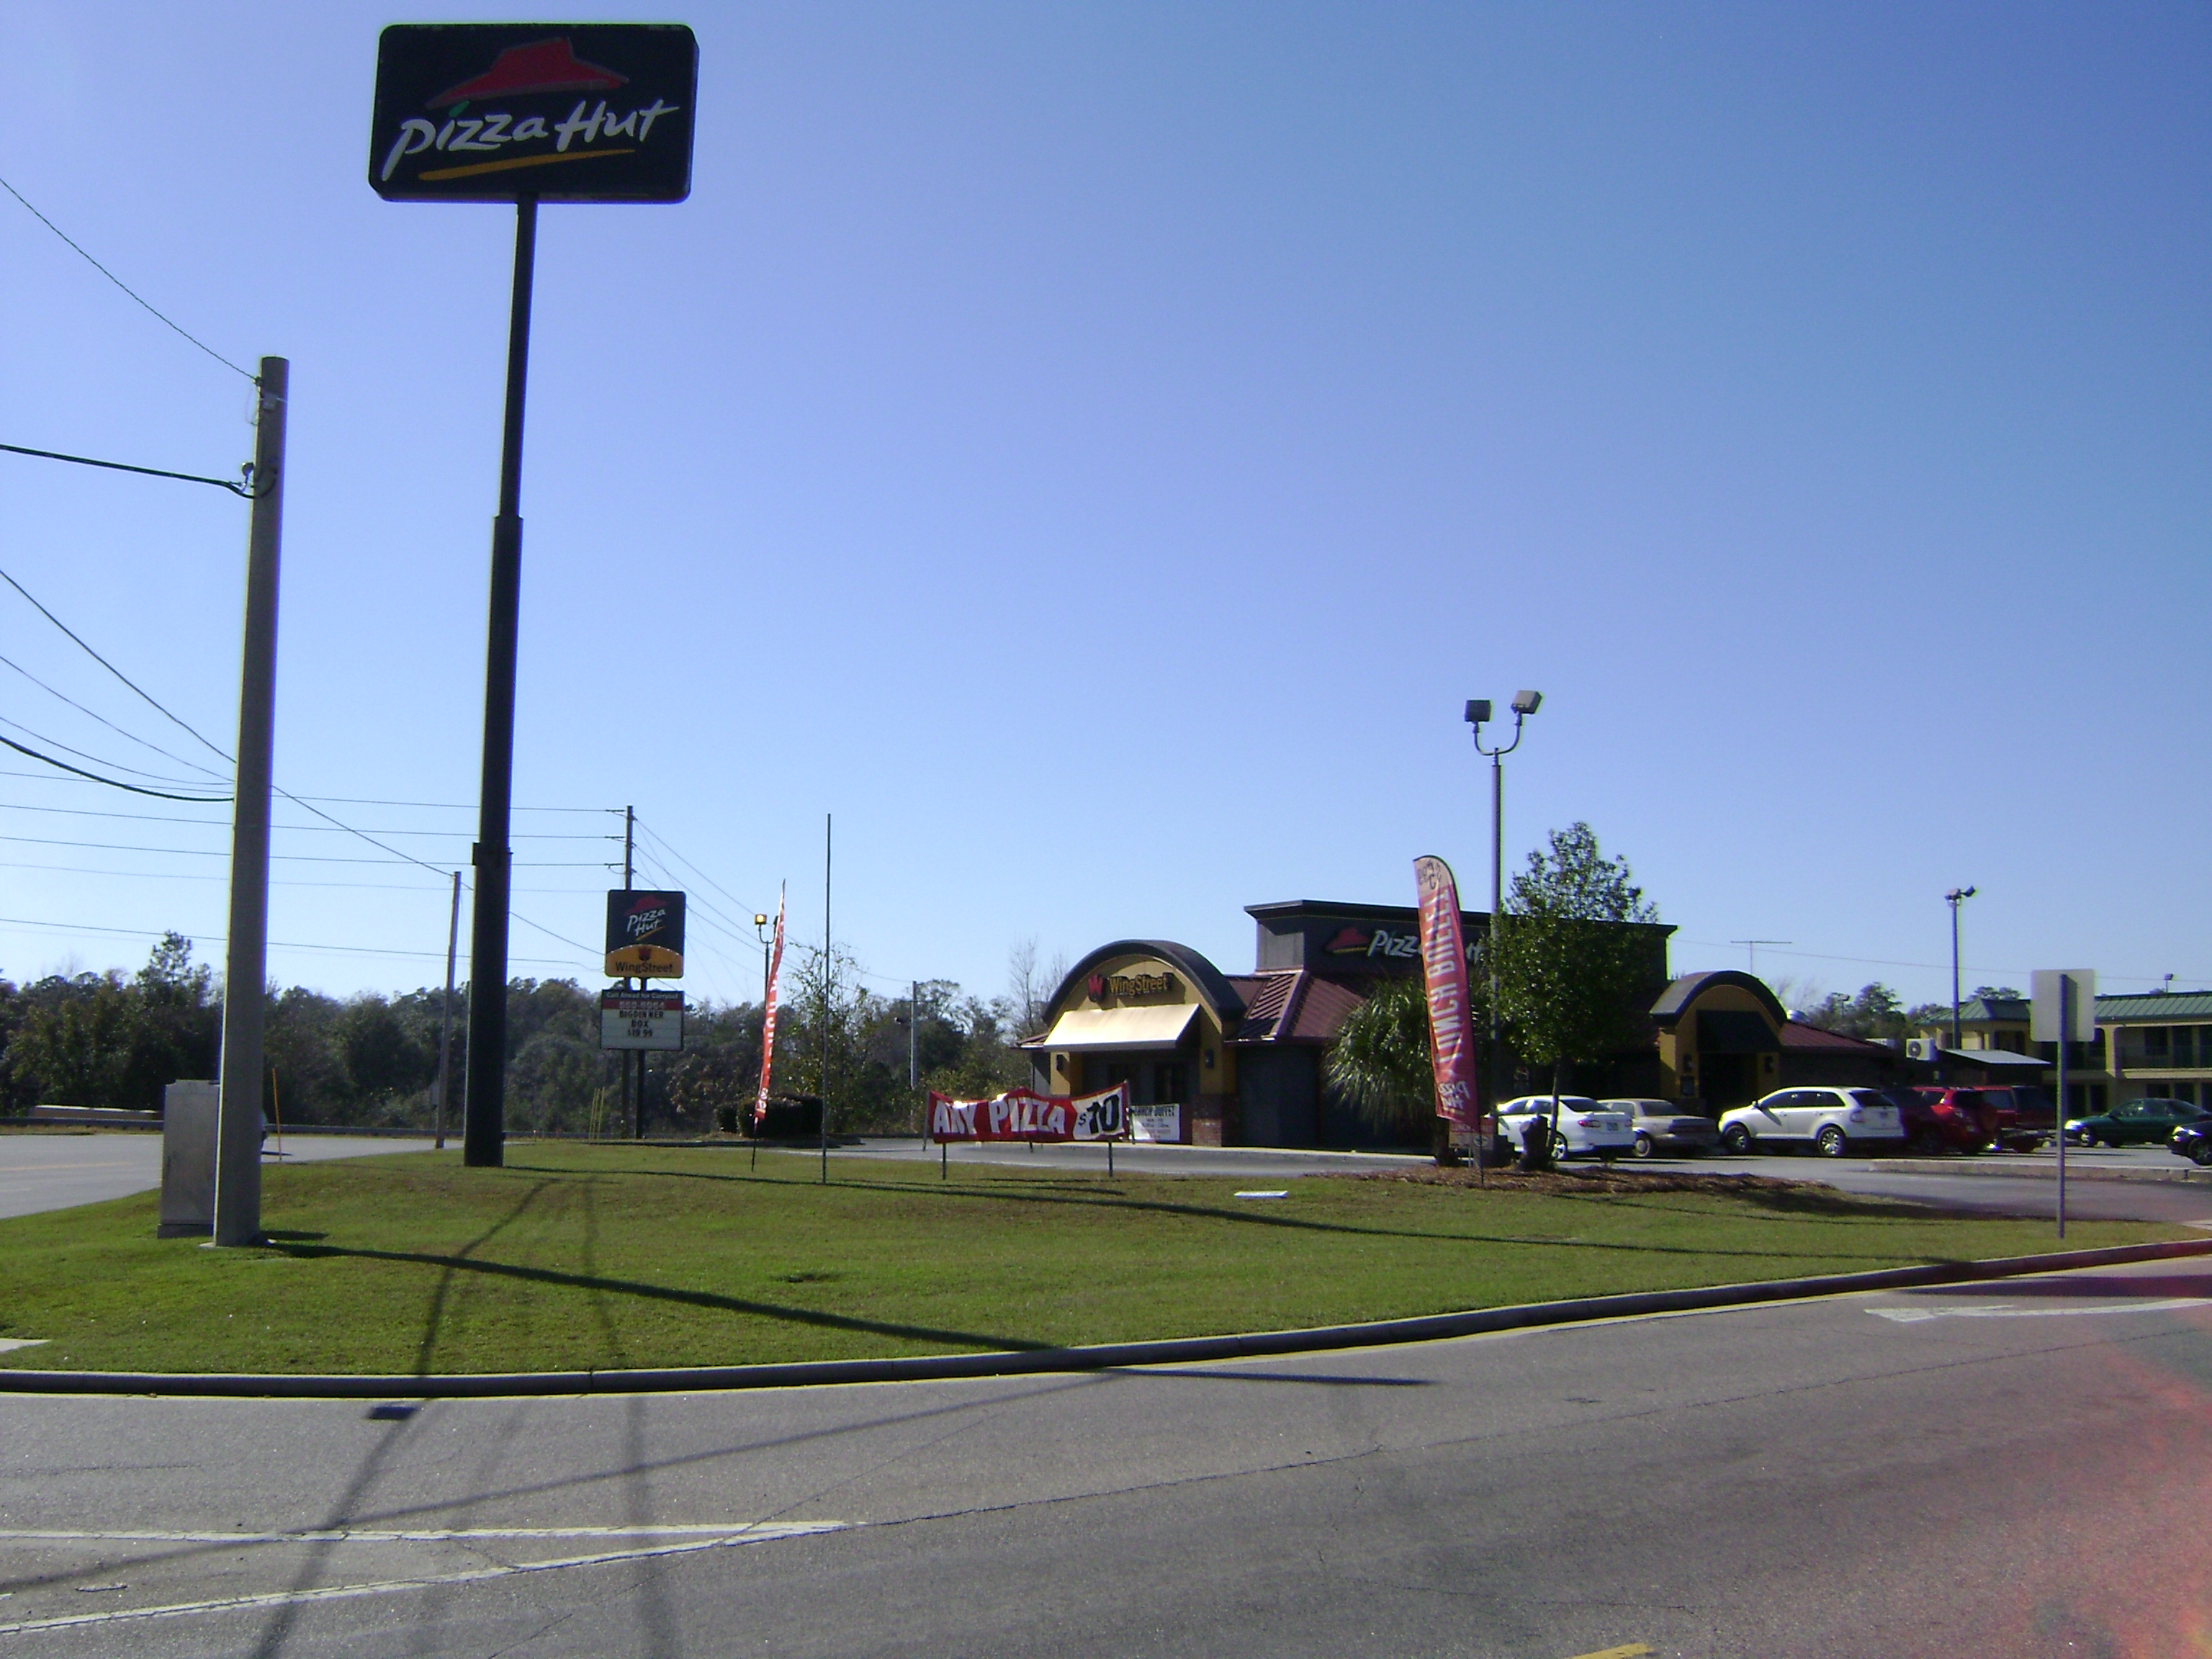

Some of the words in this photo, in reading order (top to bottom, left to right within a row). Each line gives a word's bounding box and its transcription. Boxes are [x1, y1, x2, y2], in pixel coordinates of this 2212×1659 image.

[554, 99, 680, 152] Hut
[626, 909, 666, 932] Pizza
[635, 919, 663, 937] Hut
[615, 961, 673, 974] WingStreet
[1110, 974, 1169, 996] WingStreet
[631, 1020, 649, 1028] BOX
[933, 1099, 977, 1135] ANY
[989, 1096, 1066, 1134] PIZZA
[1079, 1094, 1120, 1134] $10
